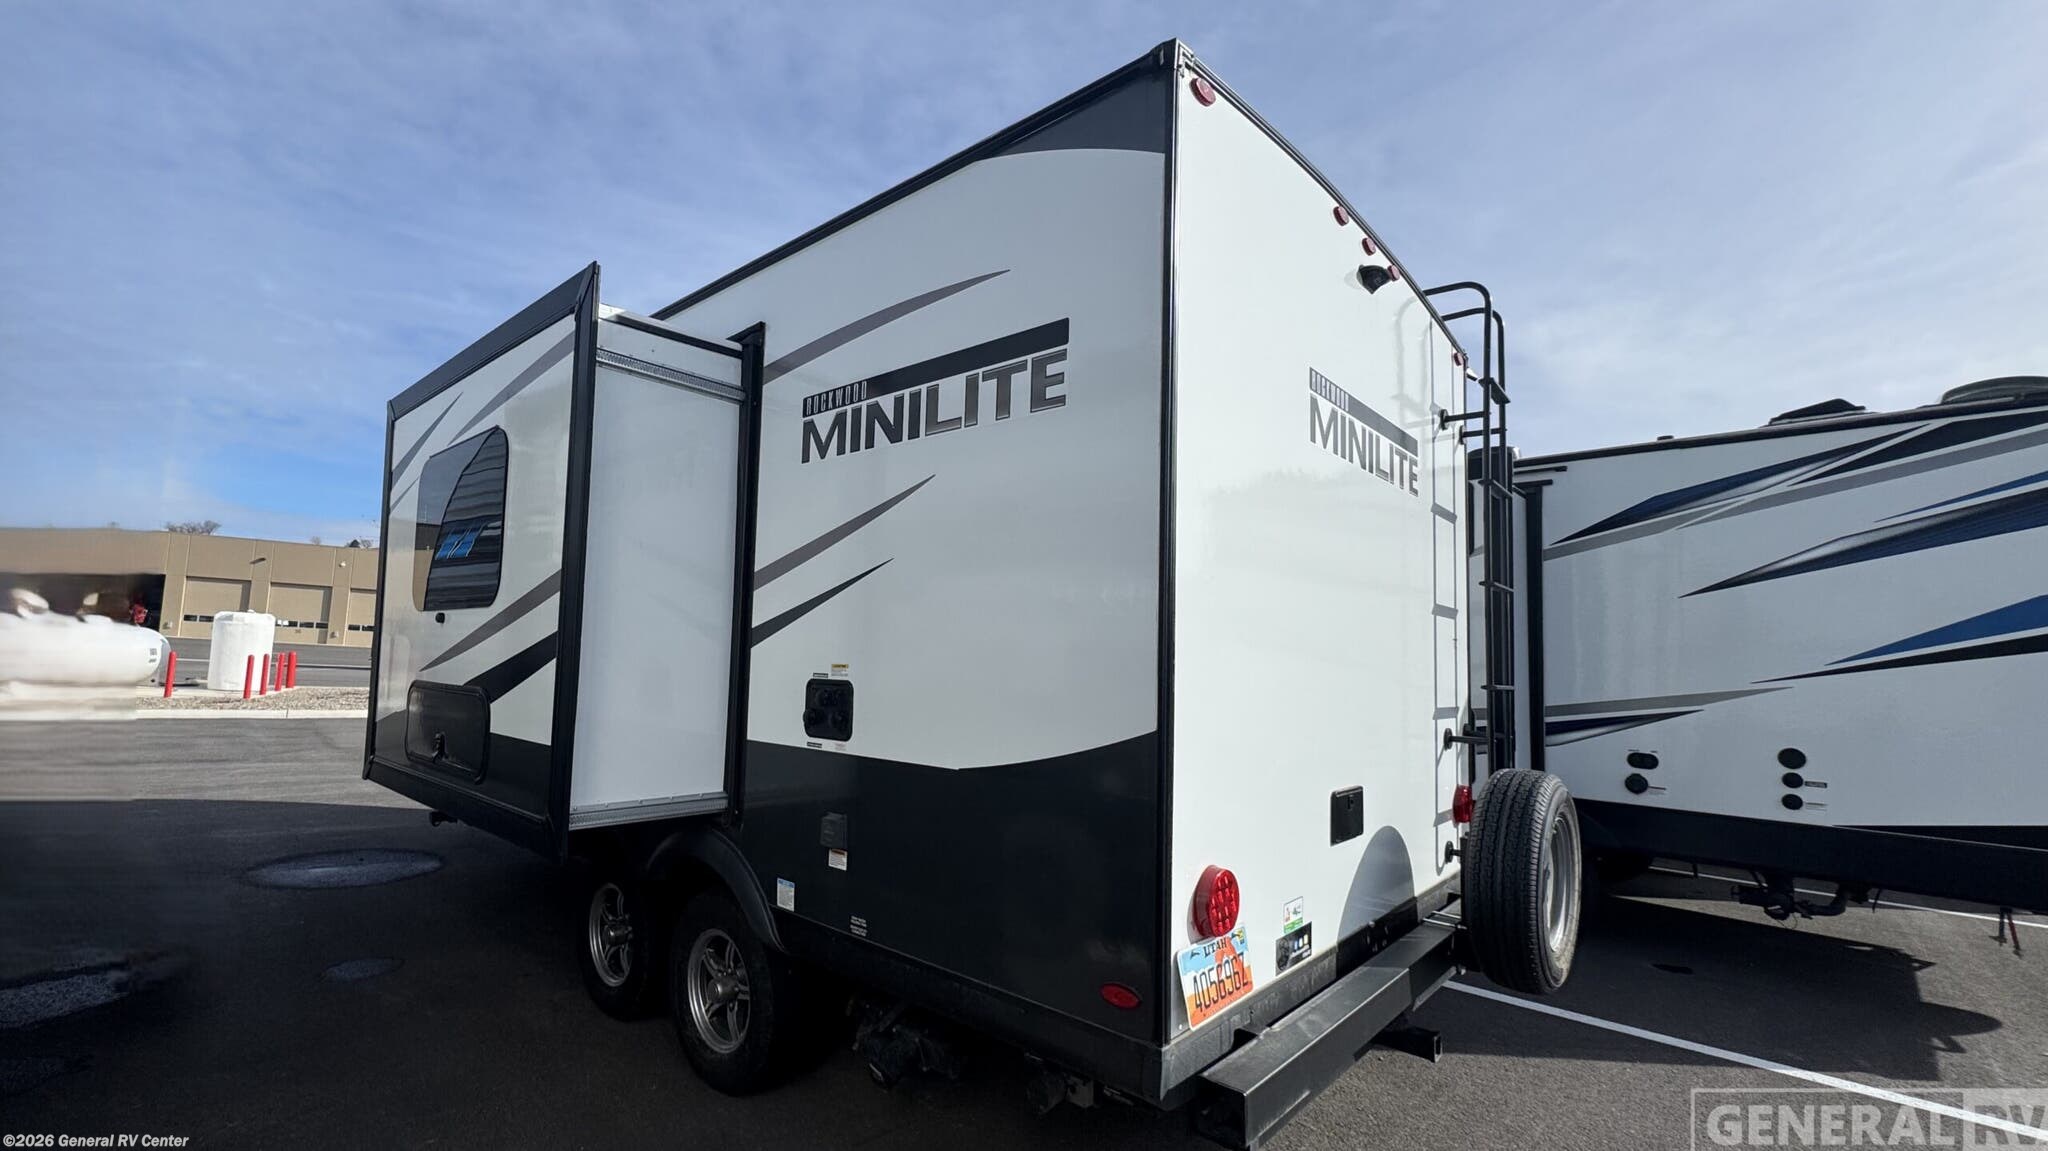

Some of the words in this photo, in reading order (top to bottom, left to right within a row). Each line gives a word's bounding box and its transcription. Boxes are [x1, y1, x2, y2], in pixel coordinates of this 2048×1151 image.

[801, 348, 1068, 464] MINILITE
[806, 380, 868, 416] ROCKWOOD
[1310, 392, 1418, 497] MINILITE
[1203, 938, 1228, 958] UTAH
